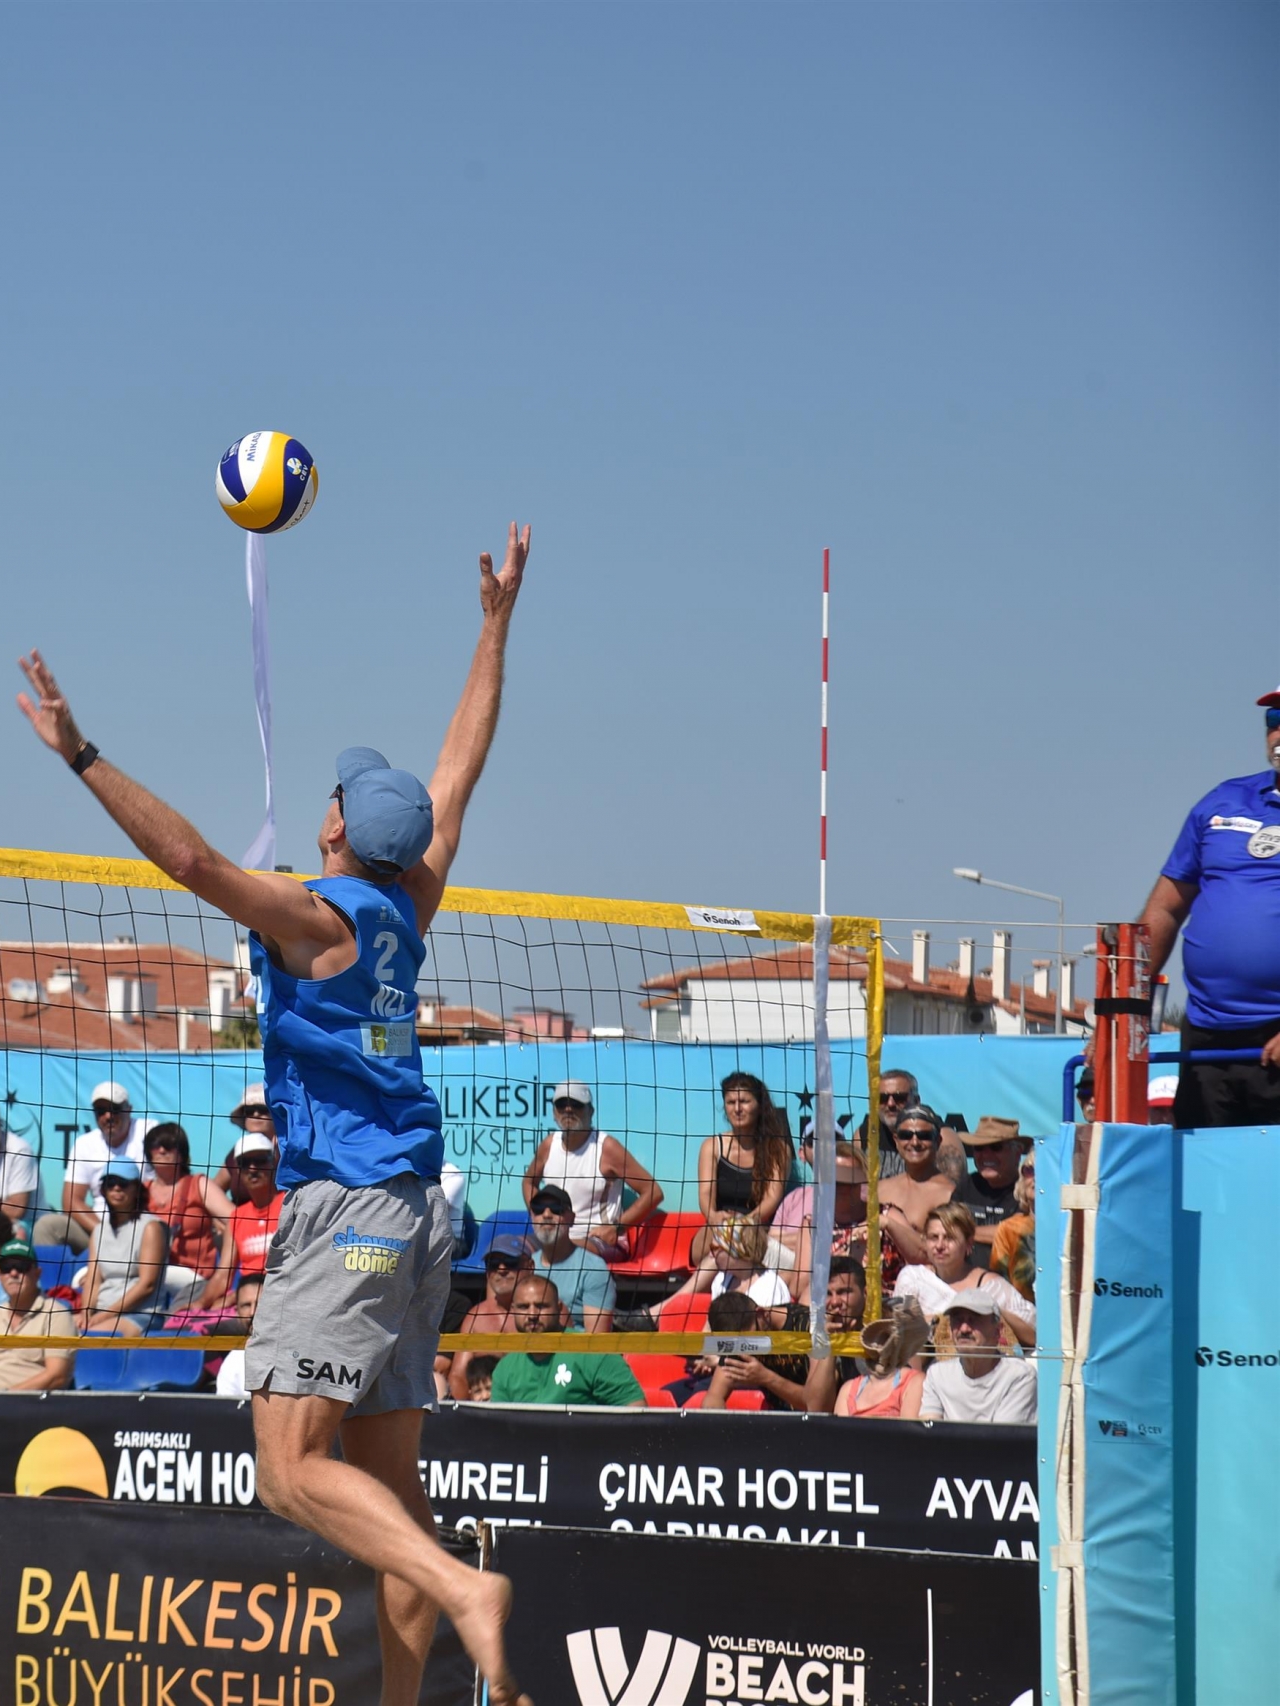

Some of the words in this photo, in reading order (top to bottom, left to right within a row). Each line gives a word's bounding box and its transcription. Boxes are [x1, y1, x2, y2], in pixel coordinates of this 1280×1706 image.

[299, 464, 309, 481] CEV
[711, 915, 741, 926] Senoh
[373, 931, 398, 981] 2
[332, 1225, 412, 1255] shower
[344, 1247, 399, 1275] dome
[1110, 1282, 1164, 1299] Senoh
[296, 1358, 363, 1389] SAM
[1217, 1350, 1280, 1367] Seno
[114, 1431, 191, 1450] SARIMSAKLI
[113, 1449, 203, 1503] ACEM
[211, 1451, 257, 1506] HO
[599, 1463, 725, 1512] ÇINAR
[737, 1467, 880, 1515] HOTEL
[926, 1476, 1040, 1522] AYVA
[17, 1567, 342, 1658] BALIKESİR
[708, 1635, 805, 1658] VOLLEYBALL
[807, 1643, 866, 1662] WORLD
[706, 1652, 866, 1706] BEACH
